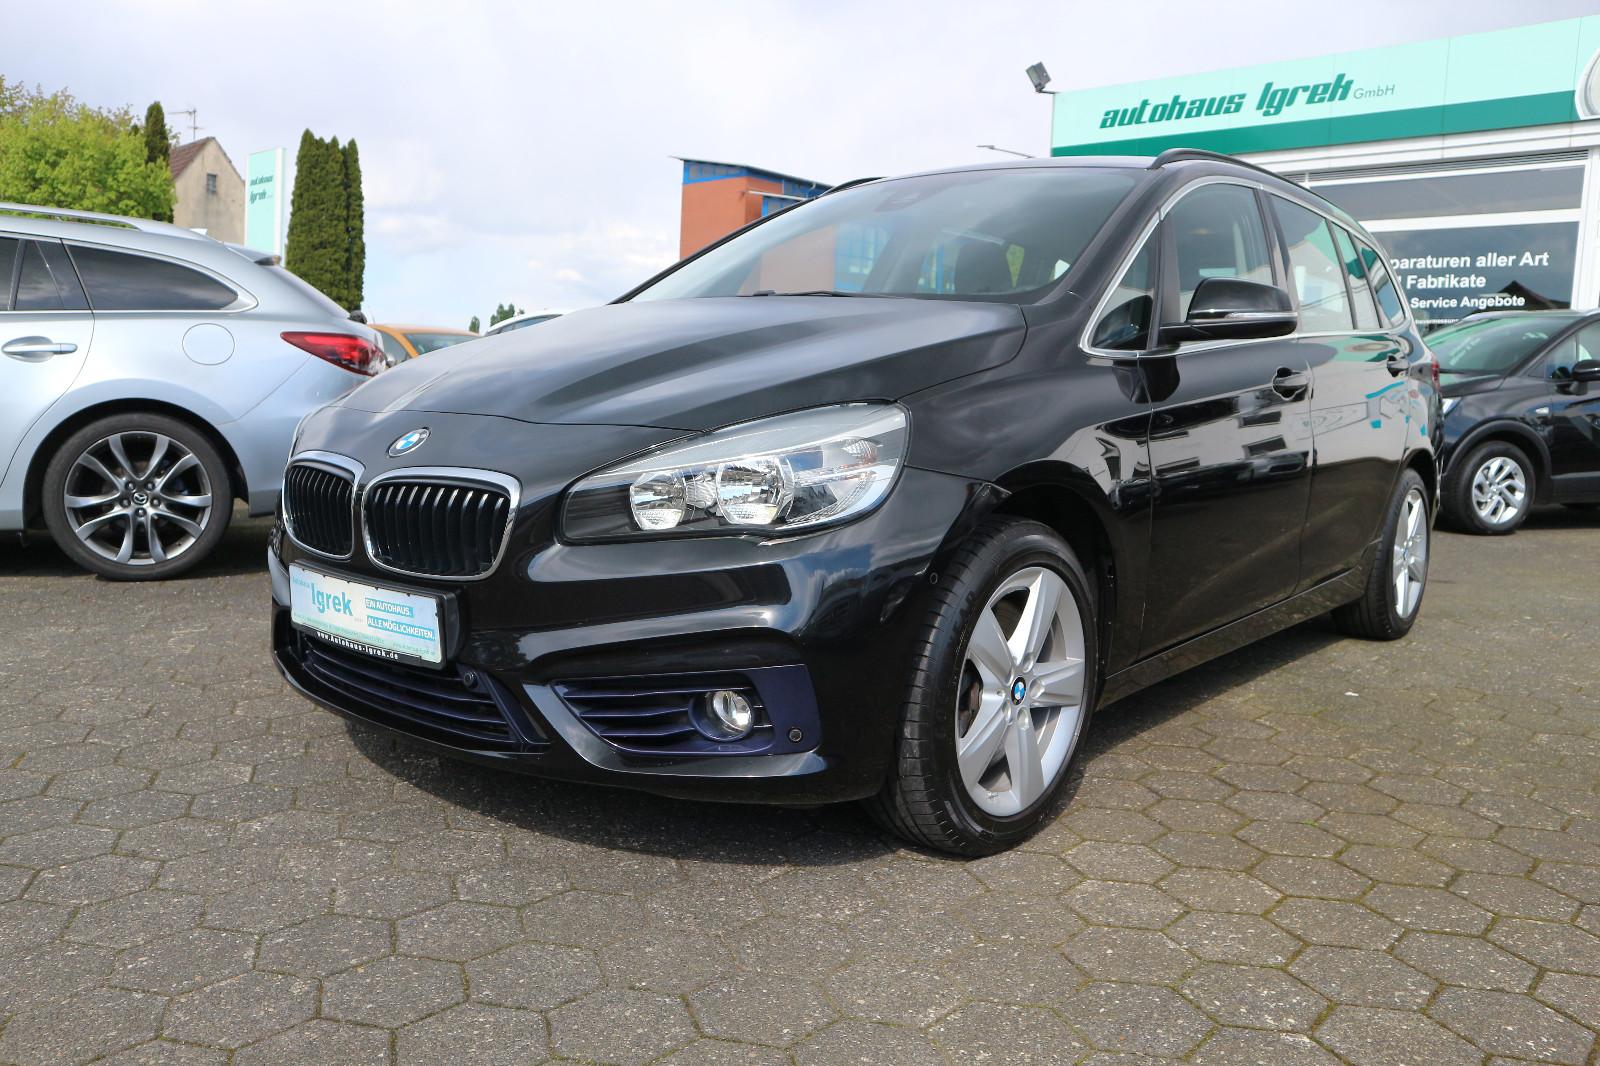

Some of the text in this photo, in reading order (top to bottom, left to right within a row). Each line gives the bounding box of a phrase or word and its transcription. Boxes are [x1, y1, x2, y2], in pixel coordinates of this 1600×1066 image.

[1099, 73, 1395, 129] autohaus Igrek GmbH
[1475, 252, 1516, 267] aller
[1518, 251, 1550, 267] Art
[1406, 273, 1487, 290] Fabrikate
[1410, 295, 1526, 310] Service Angebote
[311, 582, 354, 617] Igrek
[368, 616, 383, 628] ALLE
